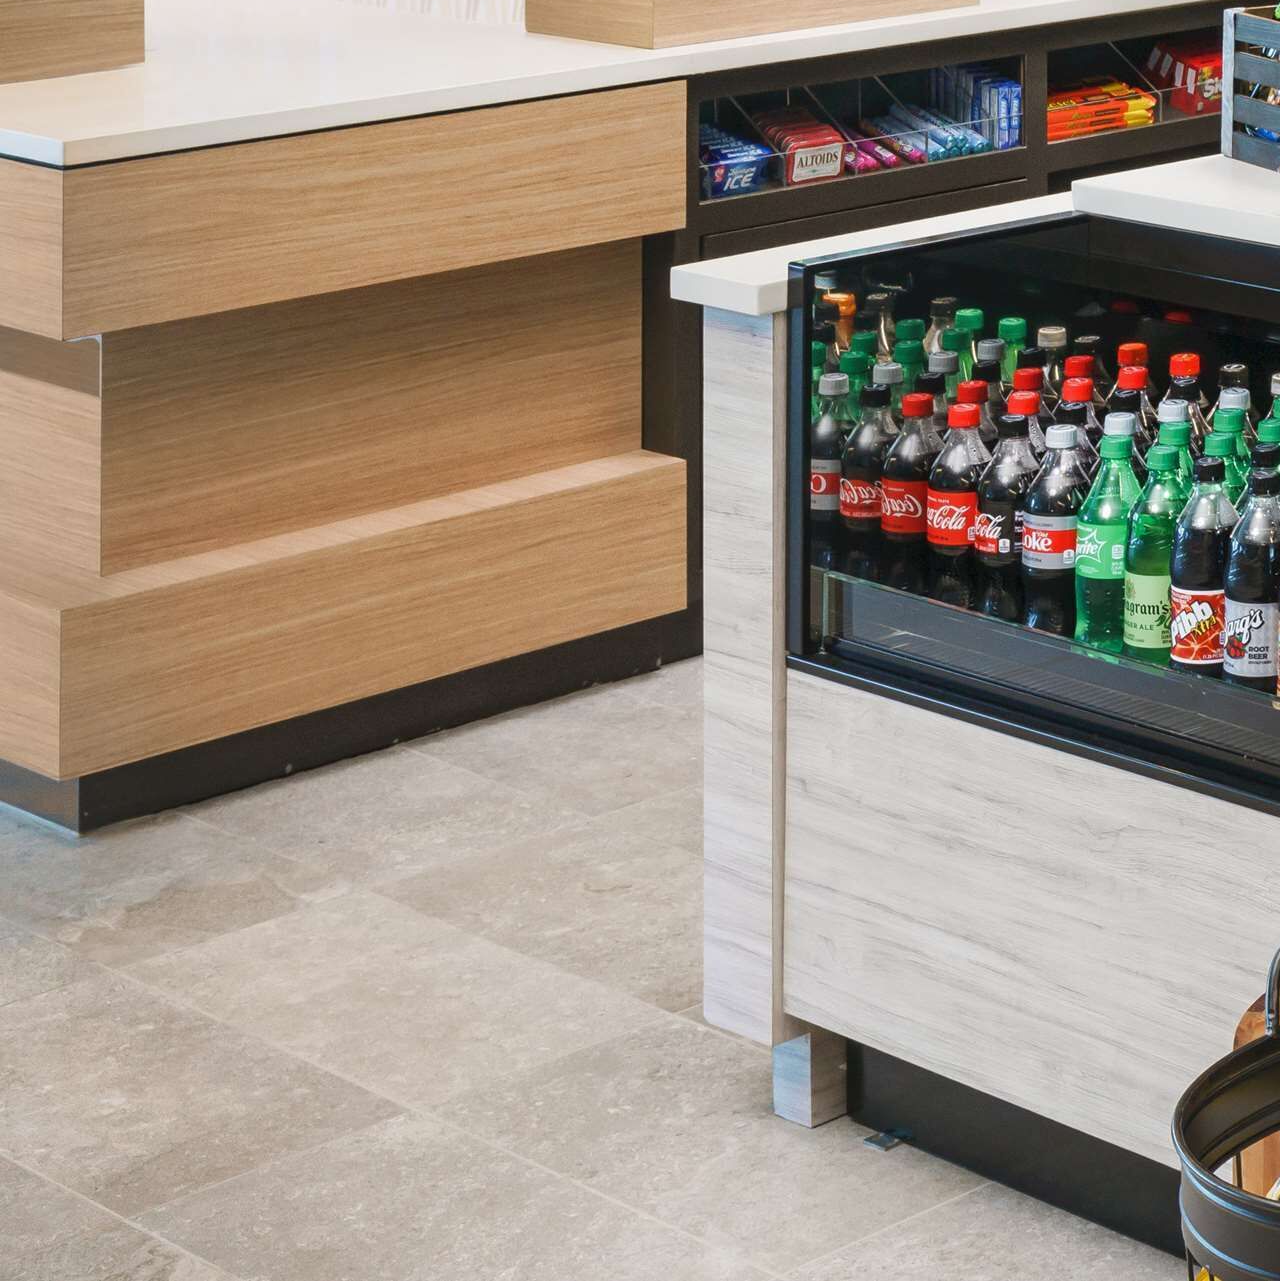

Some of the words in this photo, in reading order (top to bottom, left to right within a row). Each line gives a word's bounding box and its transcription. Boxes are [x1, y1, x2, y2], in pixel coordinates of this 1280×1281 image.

[797, 151, 839, 169] ALTOIDS
[1023, 529, 1053, 551] oke
[1125, 601, 1170, 617] agram's
